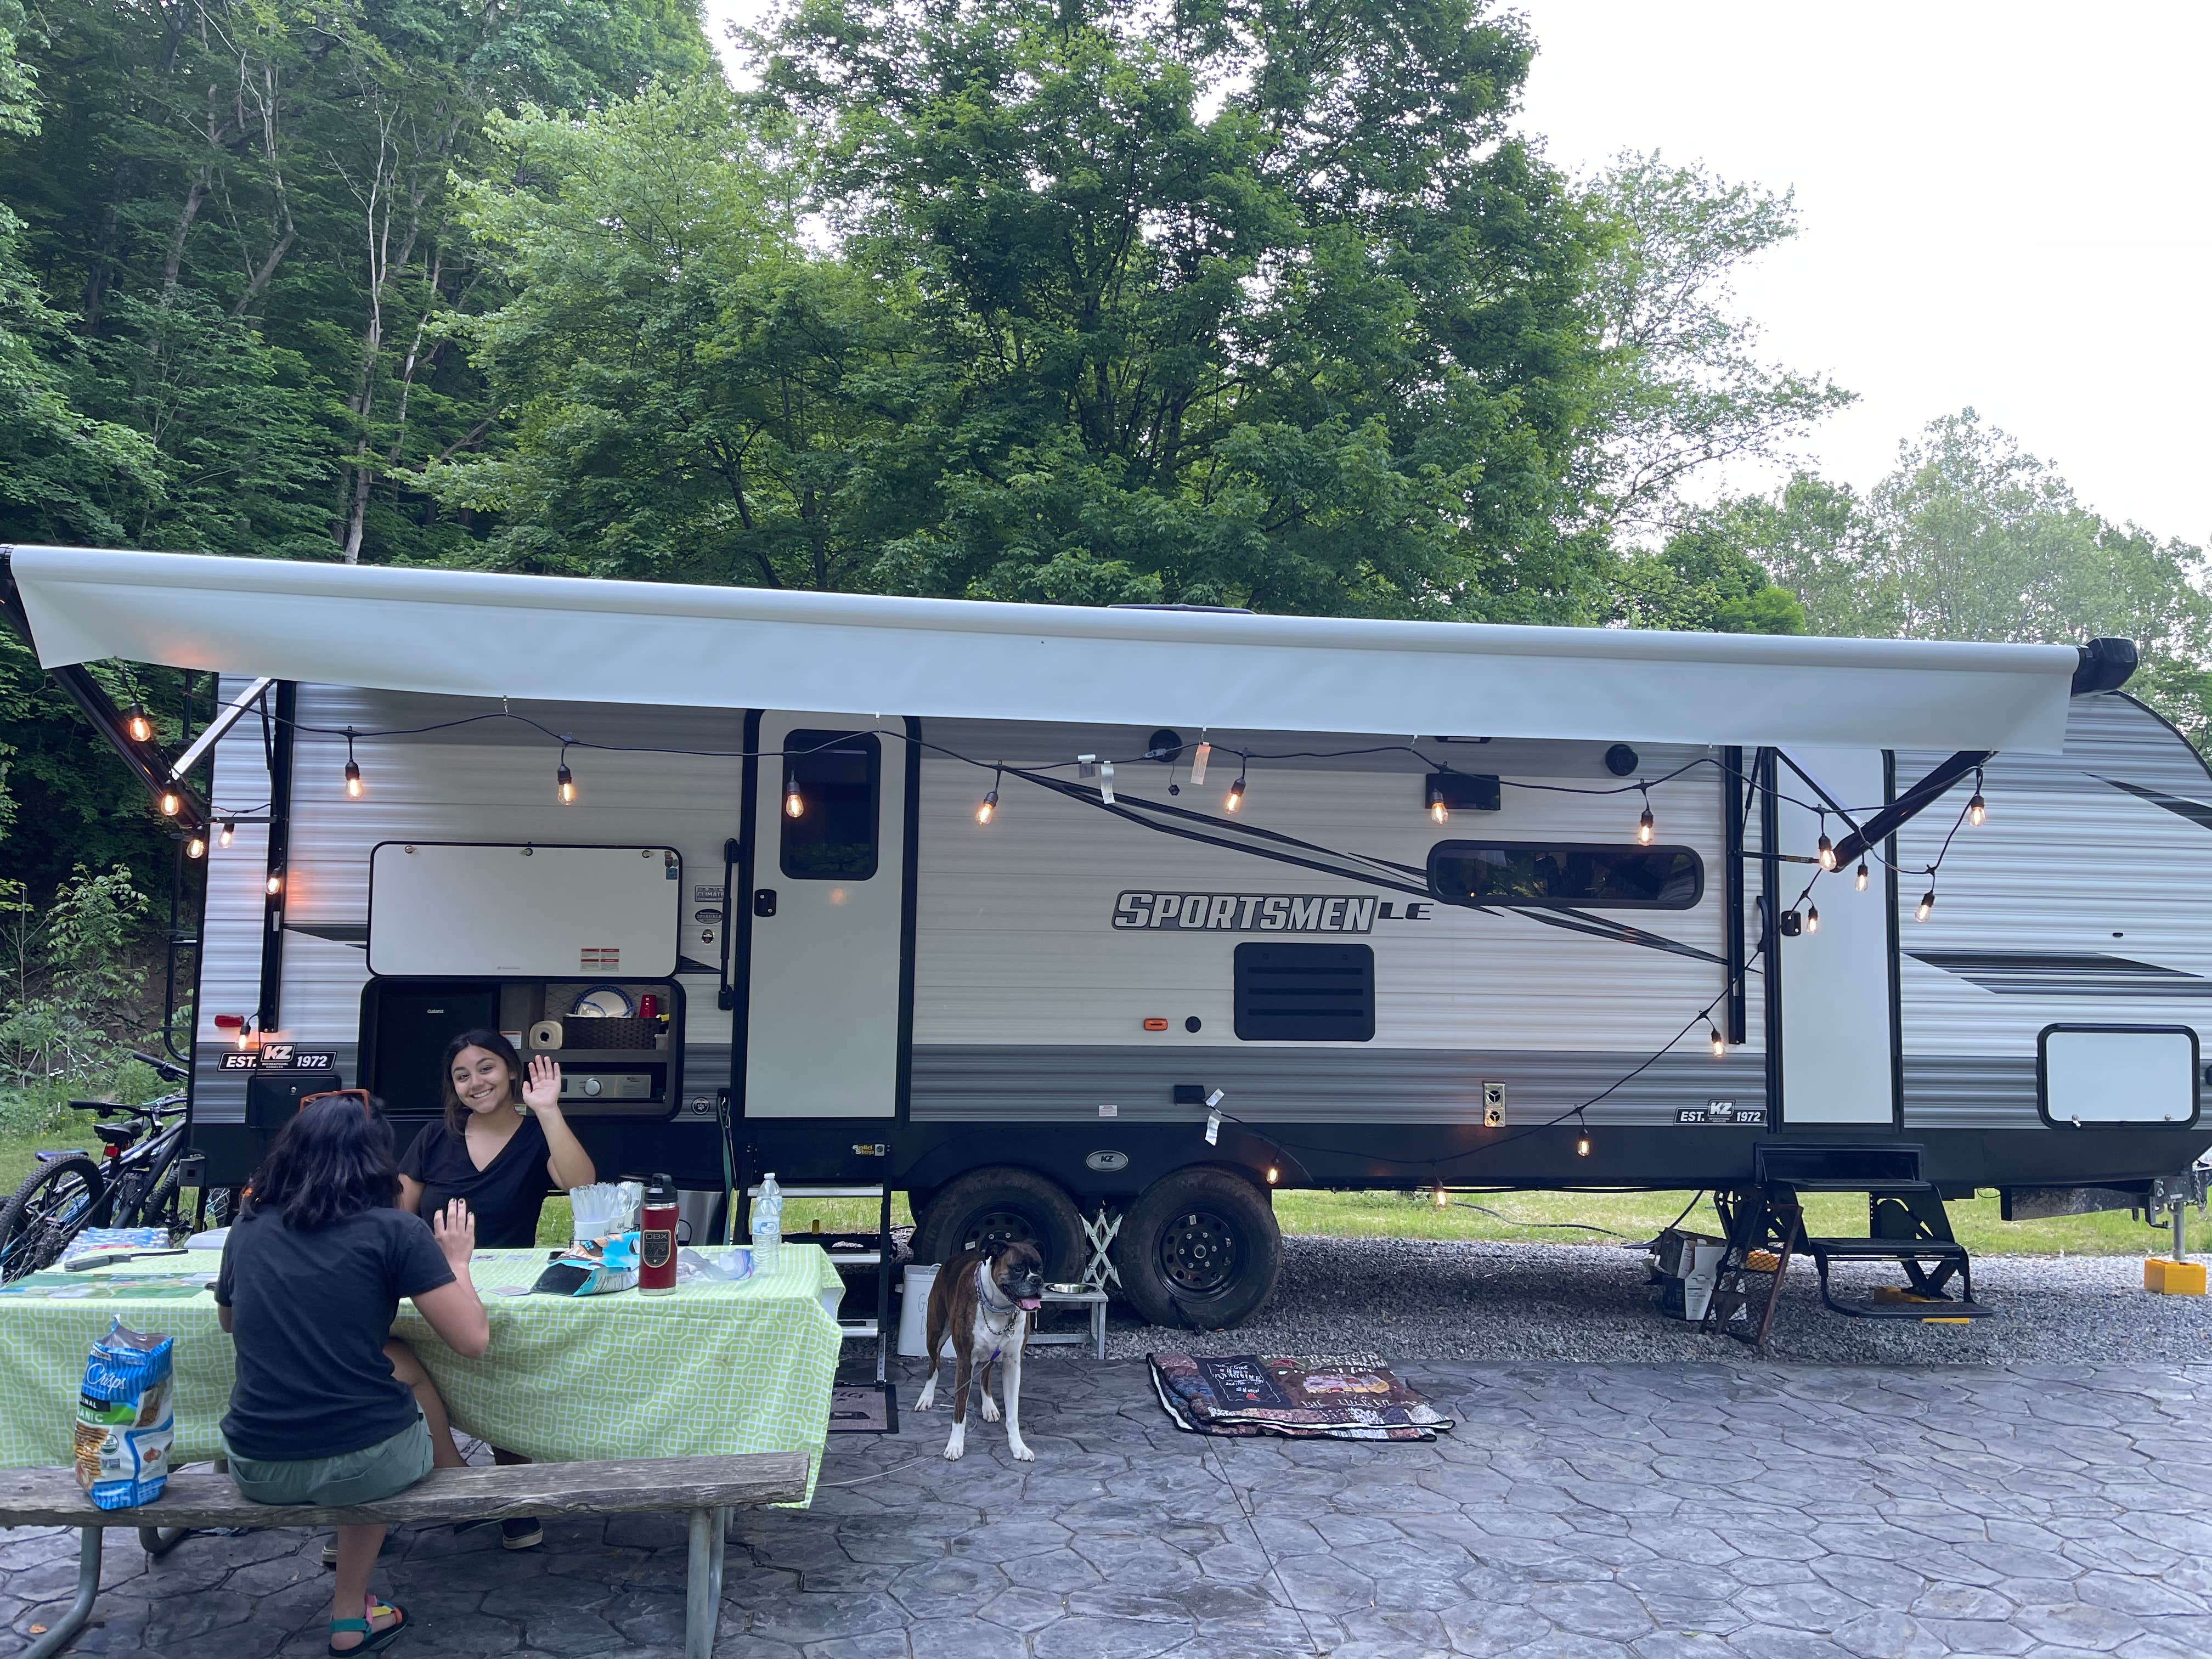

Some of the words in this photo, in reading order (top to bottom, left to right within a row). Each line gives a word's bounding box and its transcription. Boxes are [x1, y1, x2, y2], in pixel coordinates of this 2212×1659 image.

[1114, 893, 1375, 932] SPORTSMEN
[1378, 902, 1435, 921] LE
[225, 1056, 256, 1068] EST.
[263, 1046, 293, 1060] KZ
[297, 1056, 328, 1068] 1972
[1680, 1111, 1705, 1122] EST.
[1709, 1102, 1733, 1115] KZ
[1736, 1111, 1761, 1122] 1972
[1101, 1155, 1114, 1163] KZ
[87, 1363, 126, 1395] Crisps
